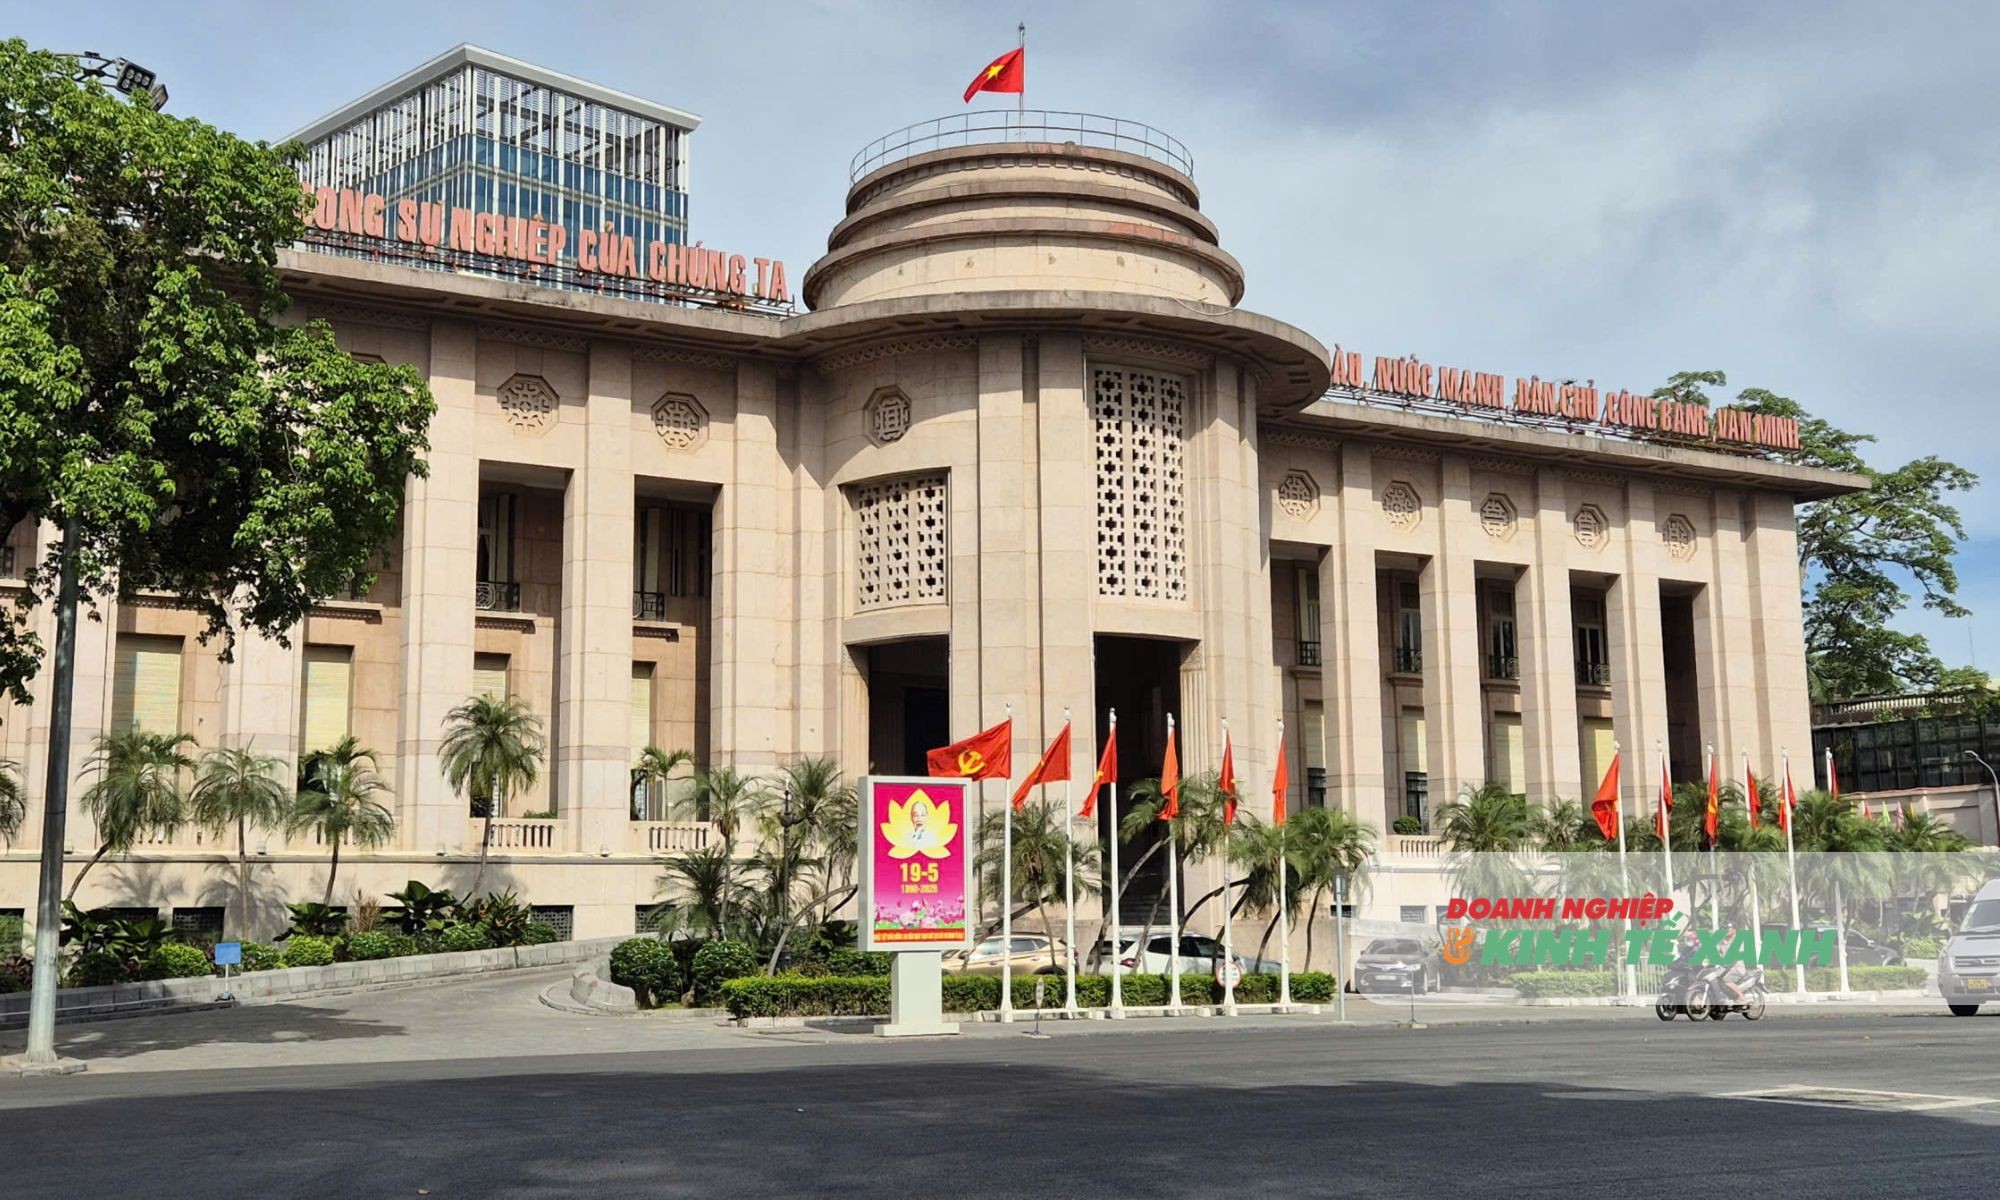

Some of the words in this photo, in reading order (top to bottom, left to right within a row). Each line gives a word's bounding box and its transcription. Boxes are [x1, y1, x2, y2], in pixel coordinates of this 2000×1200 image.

[398, 198, 443, 253] SỰ
[450, 206, 567, 273] NGHIỆP
[578, 220, 637, 278] CỦA
[649, 240, 746, 295] CHÚNG
[754, 257, 788, 301] TA
[1517, 375, 1556, 416] DÂN
[1607, 388, 1657, 429] CÔNG
[1752, 412, 1800, 450] MINH
[900, 862, 939, 882] 19-5
